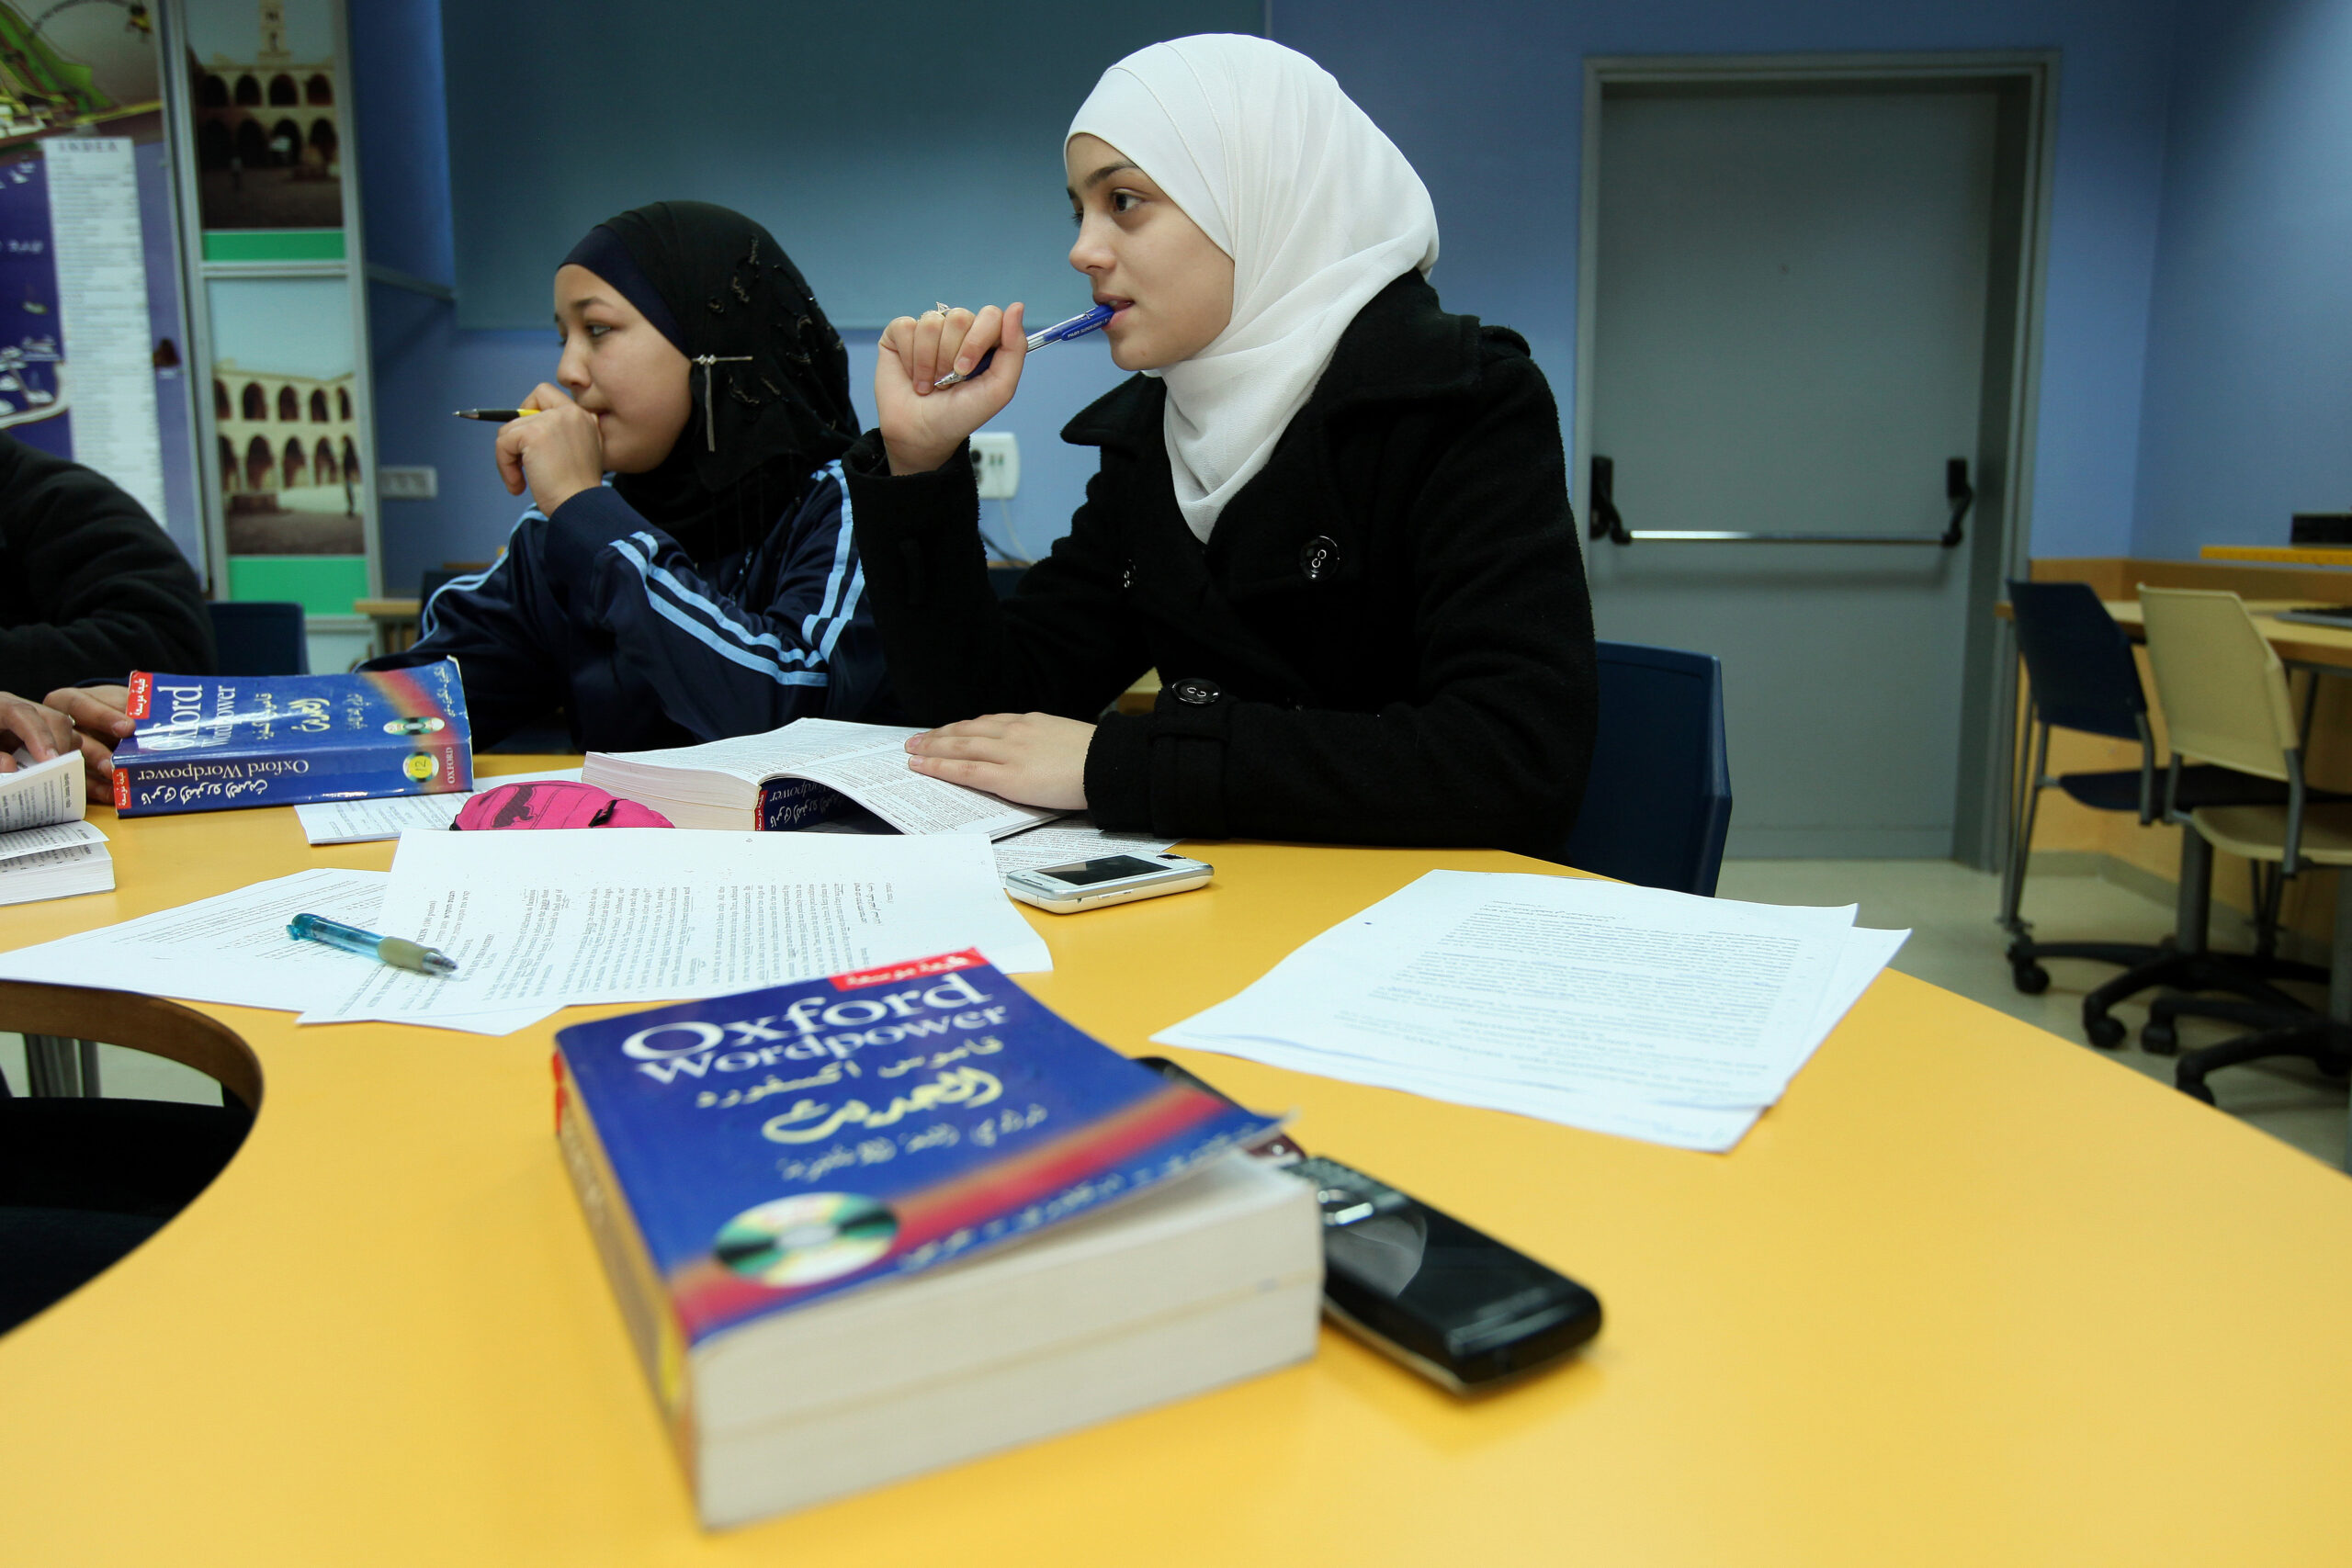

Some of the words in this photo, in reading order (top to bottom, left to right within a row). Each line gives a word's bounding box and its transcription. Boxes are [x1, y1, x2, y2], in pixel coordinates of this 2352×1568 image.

[138, 762, 243, 781] Wordpower
[247, 759, 310, 776] Oxford
[446, 747, 456, 784] OXFORD
[621, 972, 994, 1060] Oxford
[635, 1005, 1008, 1084] Wordpower
